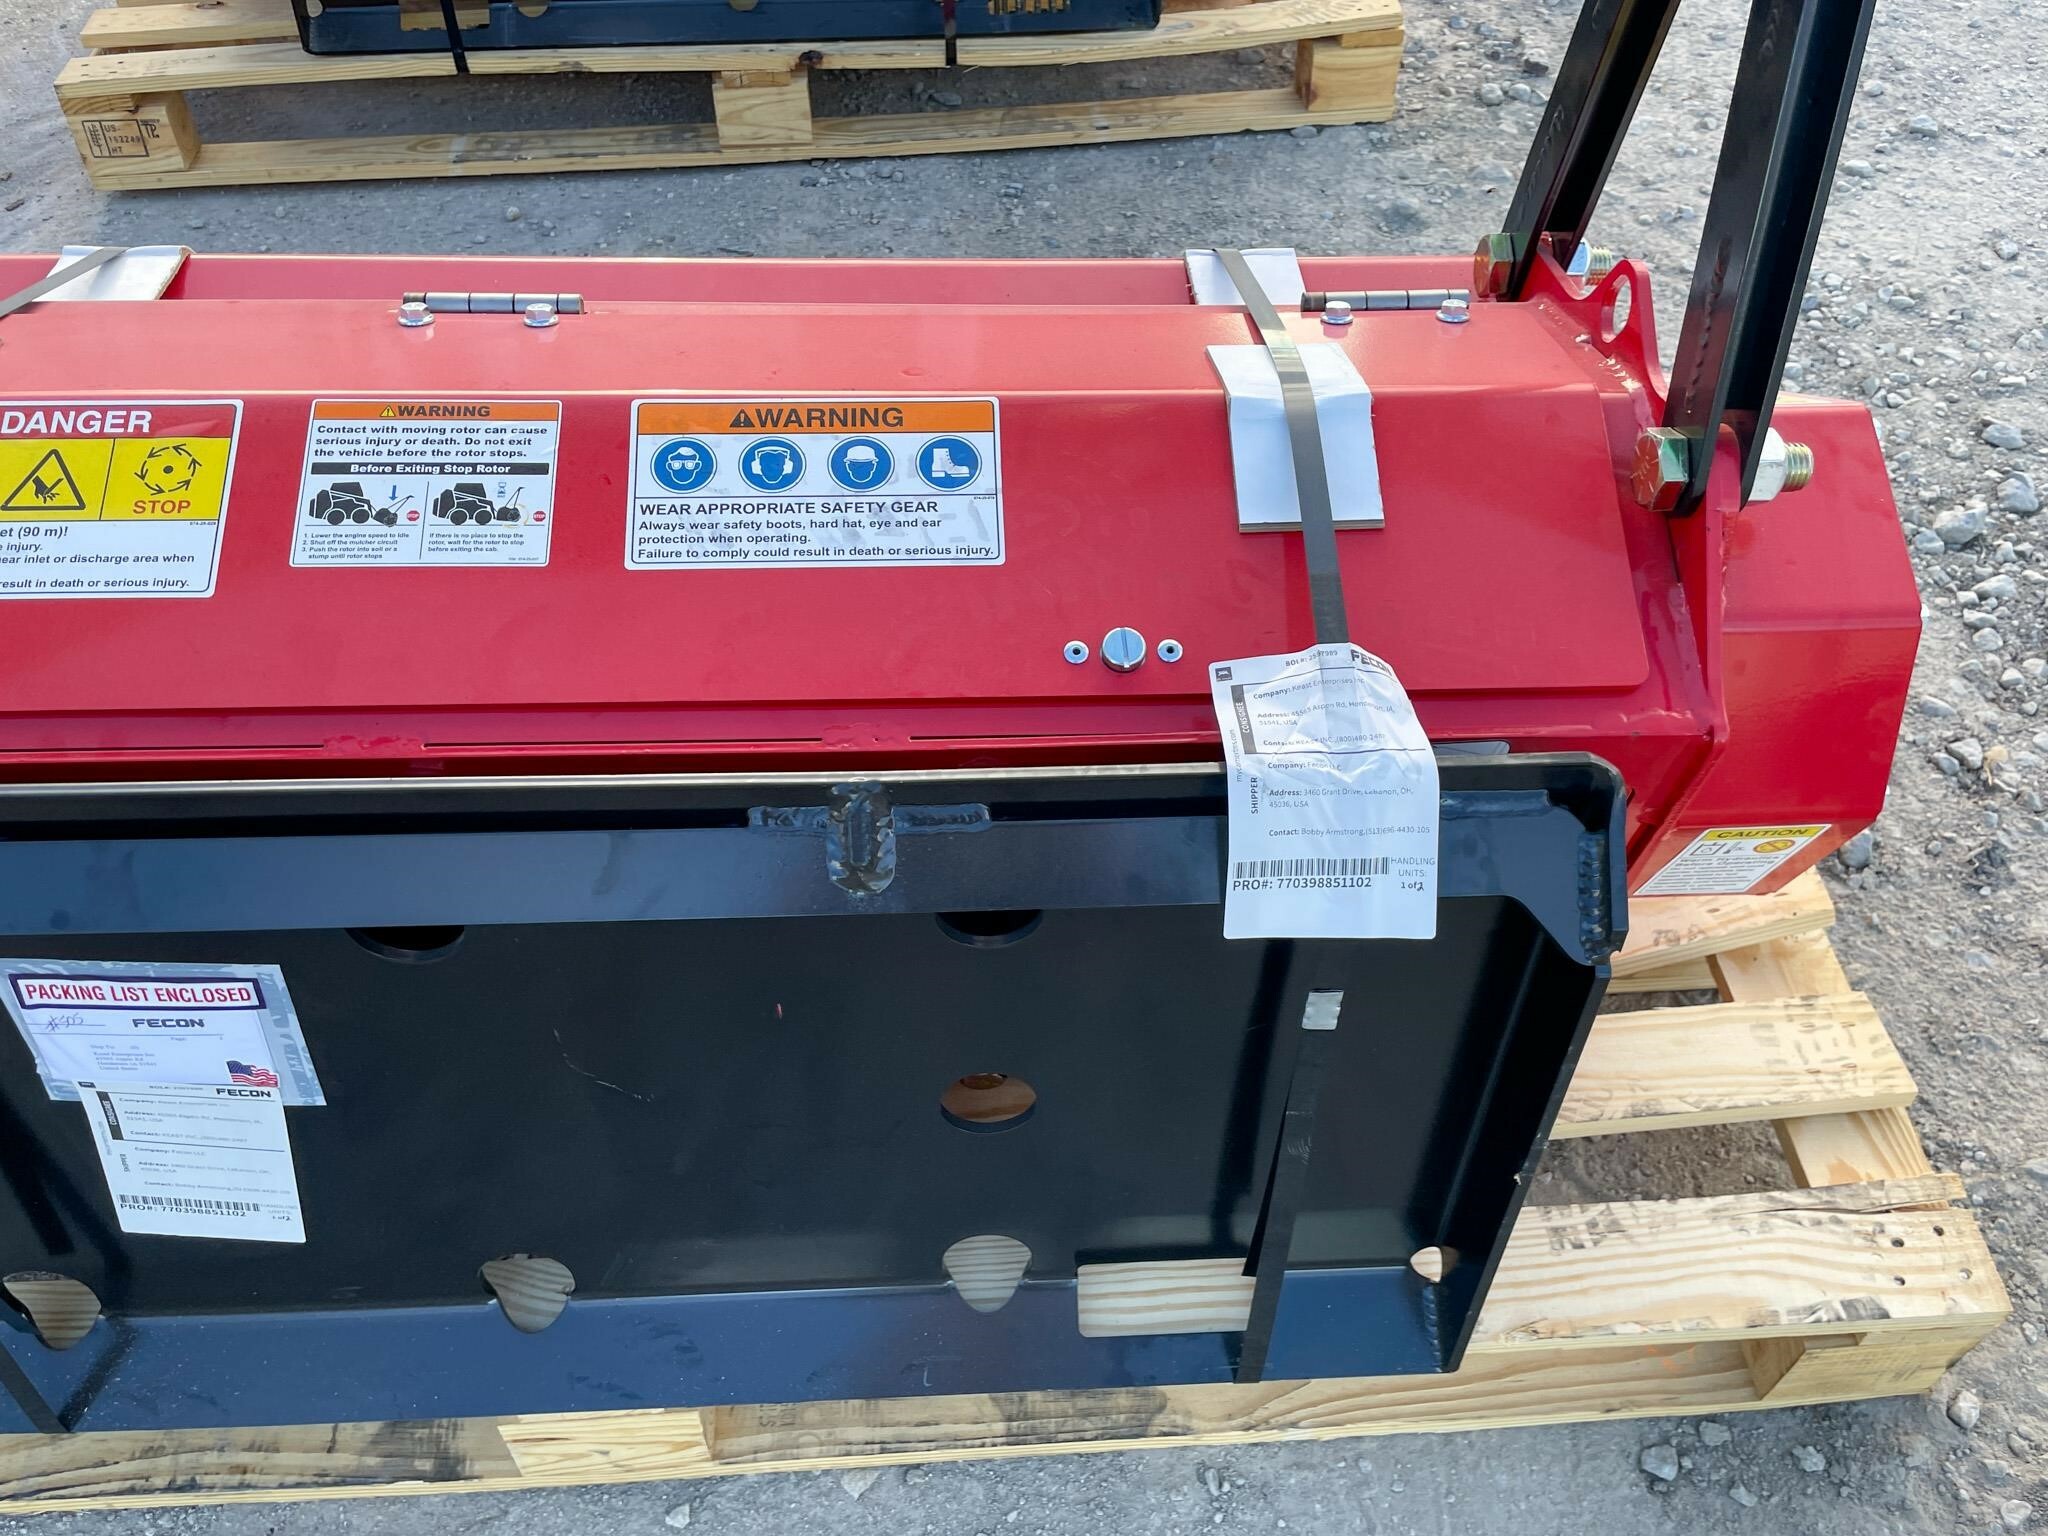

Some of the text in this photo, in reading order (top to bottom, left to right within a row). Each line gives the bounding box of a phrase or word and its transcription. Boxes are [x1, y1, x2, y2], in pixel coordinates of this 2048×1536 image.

[398, 406, 490, 416] WARNING
[1, 411, 152, 433] DANGER
[756, 408, 904, 427] WARNING
[402, 426, 446, 435] moving
[316, 437, 361, 445] serious
[366, 437, 400, 446] injury
[490, 450, 527, 458] stops.
[351, 464, 510, 474] Before Exiting Stop Rotor
[133, 500, 190, 514] STOP
[640, 502, 938, 515] WEAR APPROPRIATE SAFETY GEAR
[639, 521, 685, 532] Always
[724, 520, 762, 530] safety
[767, 520, 805, 530] boots,
[810, 519, 838, 528] hard
[843, 519, 865, 528] hat,
[869, 521, 891, 529] eye
[895, 519, 918, 527] and
[18, 526, 40, 539] (90
[45, 526, 68, 539] m)!
[639, 533, 810, 546] protection when operating.
[7, 543, 43, 553] injury.
[638, 549, 682, 558] Failure
[703, 548, 749, 559] comply
[754, 548, 790, 556] could
[794, 547, 829, 556] result
[834, 547, 845, 555] in
[849, 546, 888, 555] death
[892, 547, 900, 555] or
[905, 545, 951, 555] serious
[955, 545, 993, 556] injury.
[24, 555, 50, 563] inlet
[70, 554, 129, 565] discharge
[163, 554, 194, 562] when
[35, 579, 46, 587] in
[51, 579, 83, 587] death
[104, 579, 149, 587] serious
[153, 578, 189, 588] injury.
[1351, 650, 1393, 676] FECON
[1254, 688, 1291, 699] Company:
[1301, 828, 1324, 836] Bobby
[1718, 829, 1808, 838] CAUTION
[1391, 857, 1436, 865] HANDLING
[1233, 877, 1371, 891] PRO#: 770398851102
[25, 983, 251, 1003] PACKING LIST ENCLOSED
[132, 1018, 205, 1028] FECON
[216, 1088, 272, 1098] FECON
[120, 1204, 247, 1217] PRO#: 770398851102
